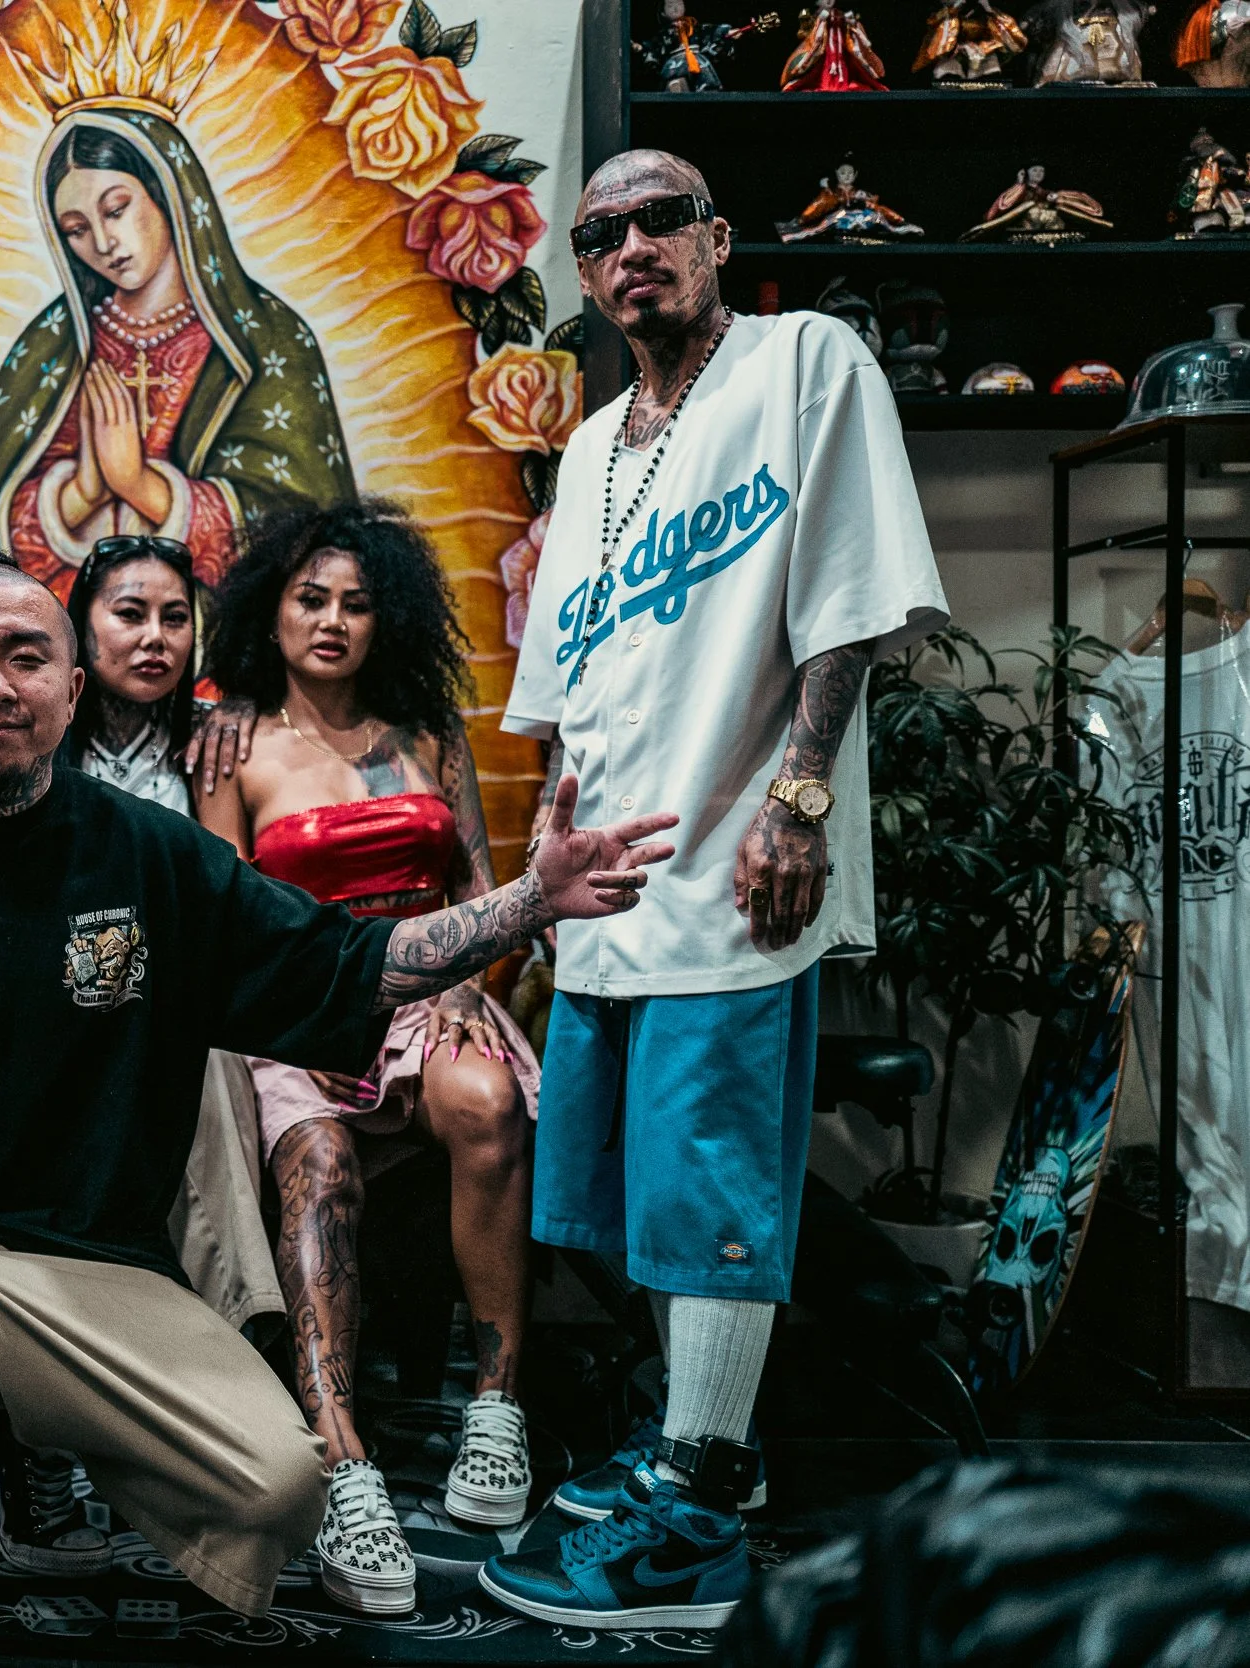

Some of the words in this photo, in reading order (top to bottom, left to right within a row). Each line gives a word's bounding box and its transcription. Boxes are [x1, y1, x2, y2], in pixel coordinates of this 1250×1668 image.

[556, 463, 790, 696] Dodgers
[75, 912, 96, 926] HOUSE
[95, 910, 104, 922] OF
[104, 907, 130, 919] CHRONIC
